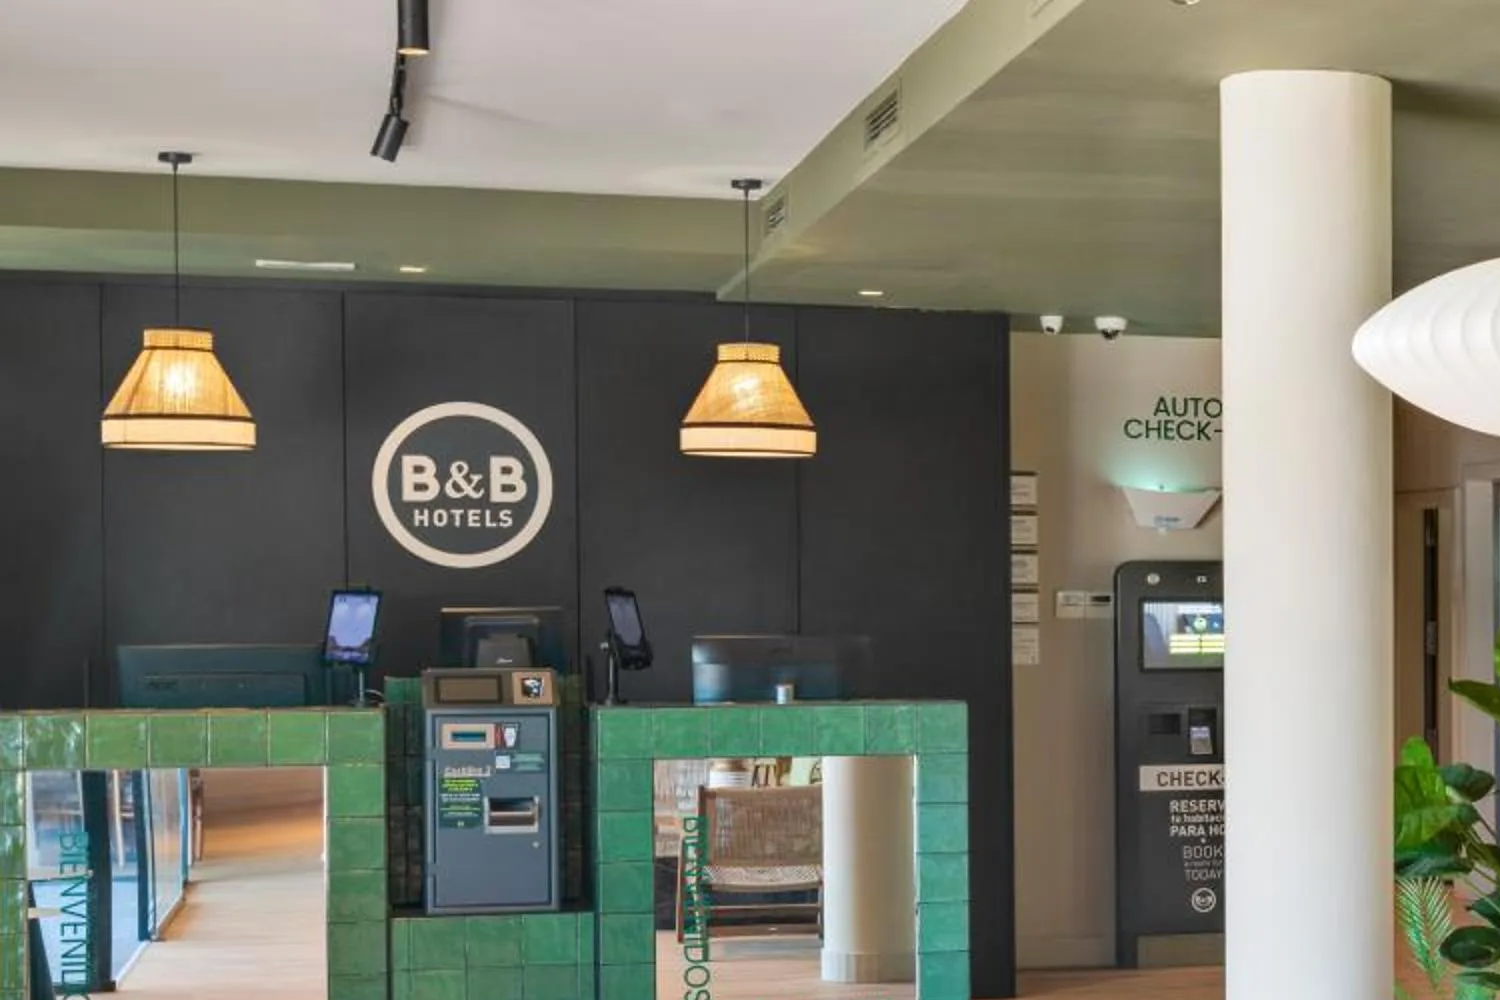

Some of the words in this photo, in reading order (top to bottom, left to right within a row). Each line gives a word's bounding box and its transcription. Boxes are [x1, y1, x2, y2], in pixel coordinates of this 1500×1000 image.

[1153, 396, 1223, 418] AUTO
[401, 455, 527, 502] B&B
[413, 508, 513, 528] HOTELS
[1169, 825, 1206, 837] PARA
[1183, 845, 1223, 859] BOOK
[1184, 868, 1223, 881] TODAY
